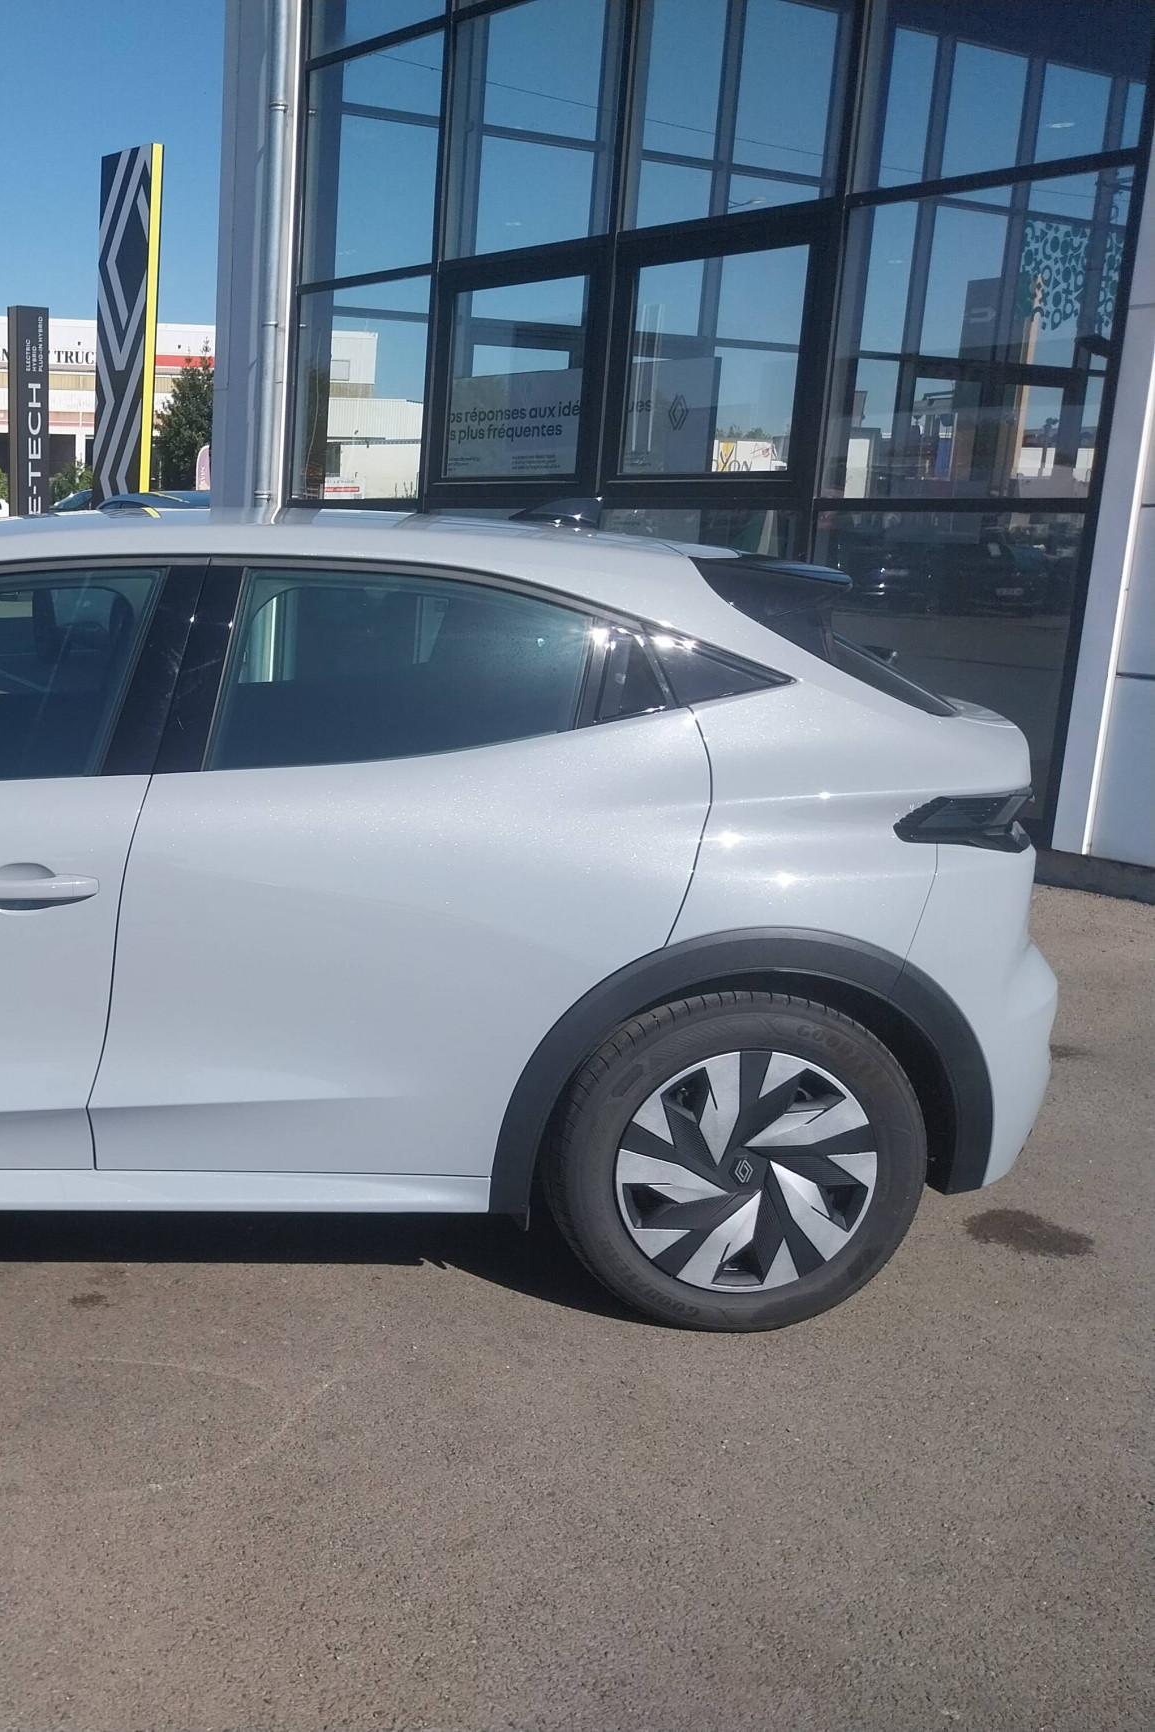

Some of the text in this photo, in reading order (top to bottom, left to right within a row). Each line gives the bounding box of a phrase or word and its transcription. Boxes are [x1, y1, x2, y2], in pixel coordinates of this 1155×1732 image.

[464, 407, 527, 426] réponses
[529, 406, 556, 419] aux
[458, 425, 485, 445] plus
[487, 423, 563, 443] fréquentes
[27, 383, 42, 515] E-TECH
